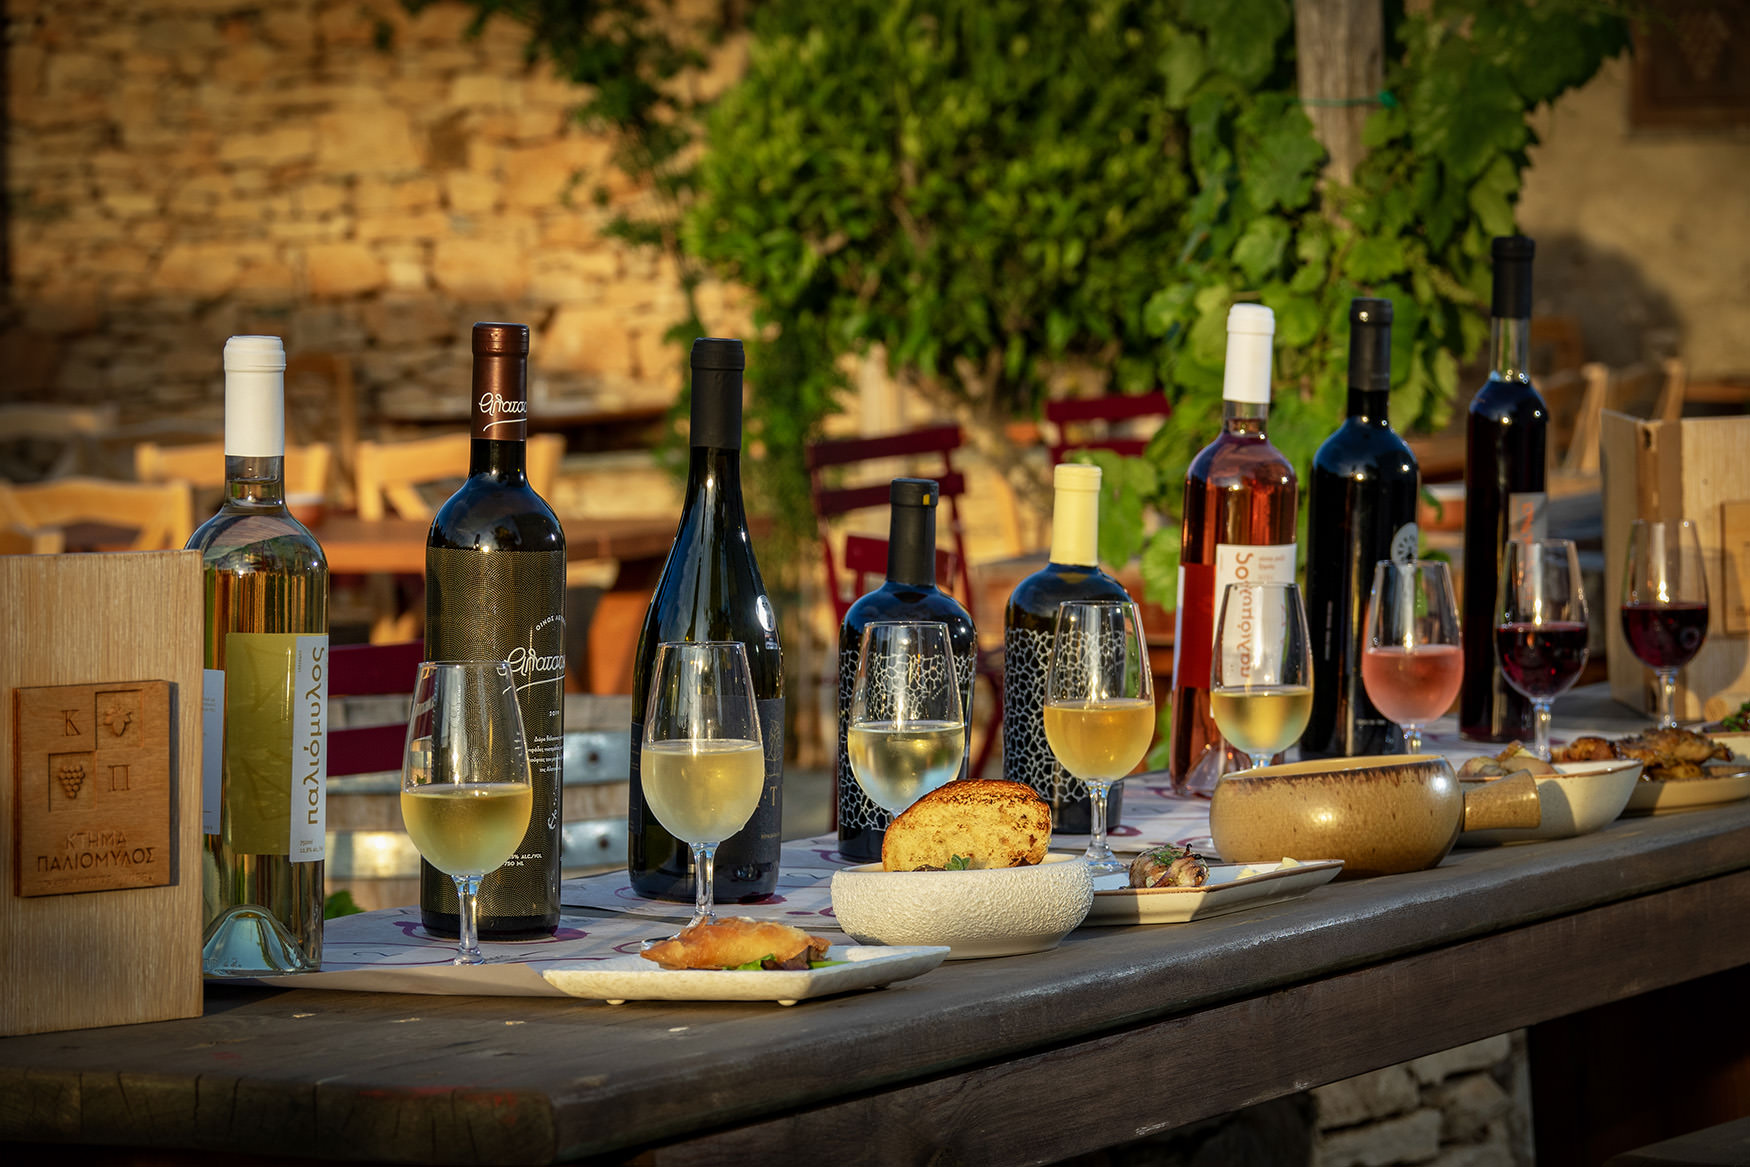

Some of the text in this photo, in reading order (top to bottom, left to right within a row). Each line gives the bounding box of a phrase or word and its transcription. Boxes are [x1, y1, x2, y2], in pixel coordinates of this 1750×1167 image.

[303, 647, 325, 825] παλιόμυλος
[64, 831, 128, 850] ΚΤΗΜΑ
[37, 846, 156, 873] ΠΑΛΙΟΜΥΛΟΣ
